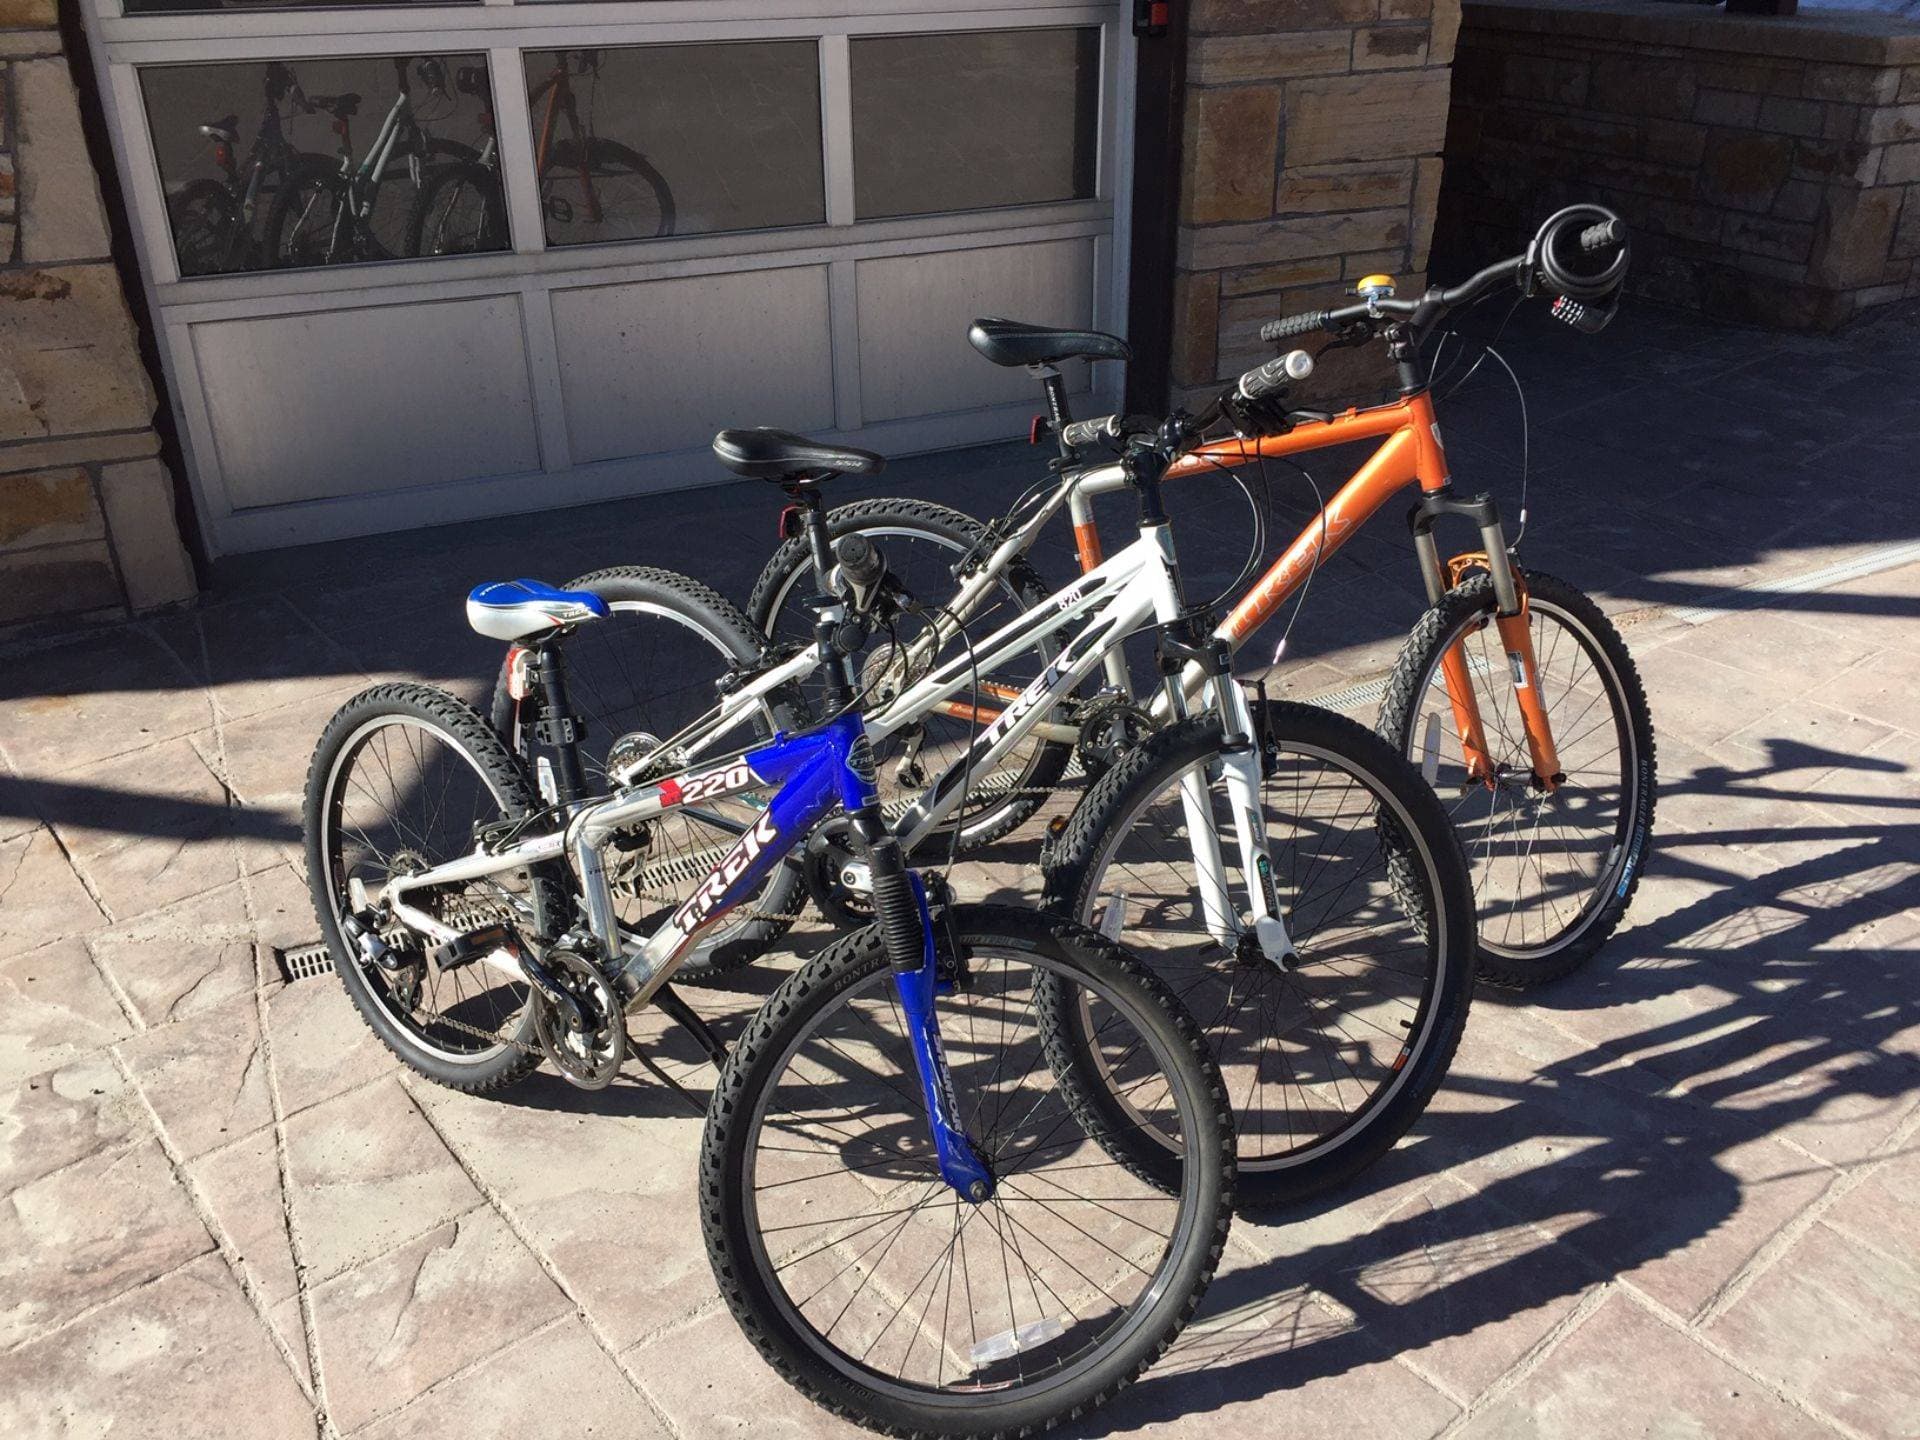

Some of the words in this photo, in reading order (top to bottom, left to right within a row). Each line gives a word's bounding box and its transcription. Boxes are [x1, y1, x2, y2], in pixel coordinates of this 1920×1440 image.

[980, 650, 1076, 745] TREK
[681, 765, 750, 804] 220
[1638, 759, 1649, 824] BONTRAGER
[674, 812, 777, 934] TREK
[1073, 826, 1112, 920] ONTRAGER
[834, 954, 888, 992] BONTRA
